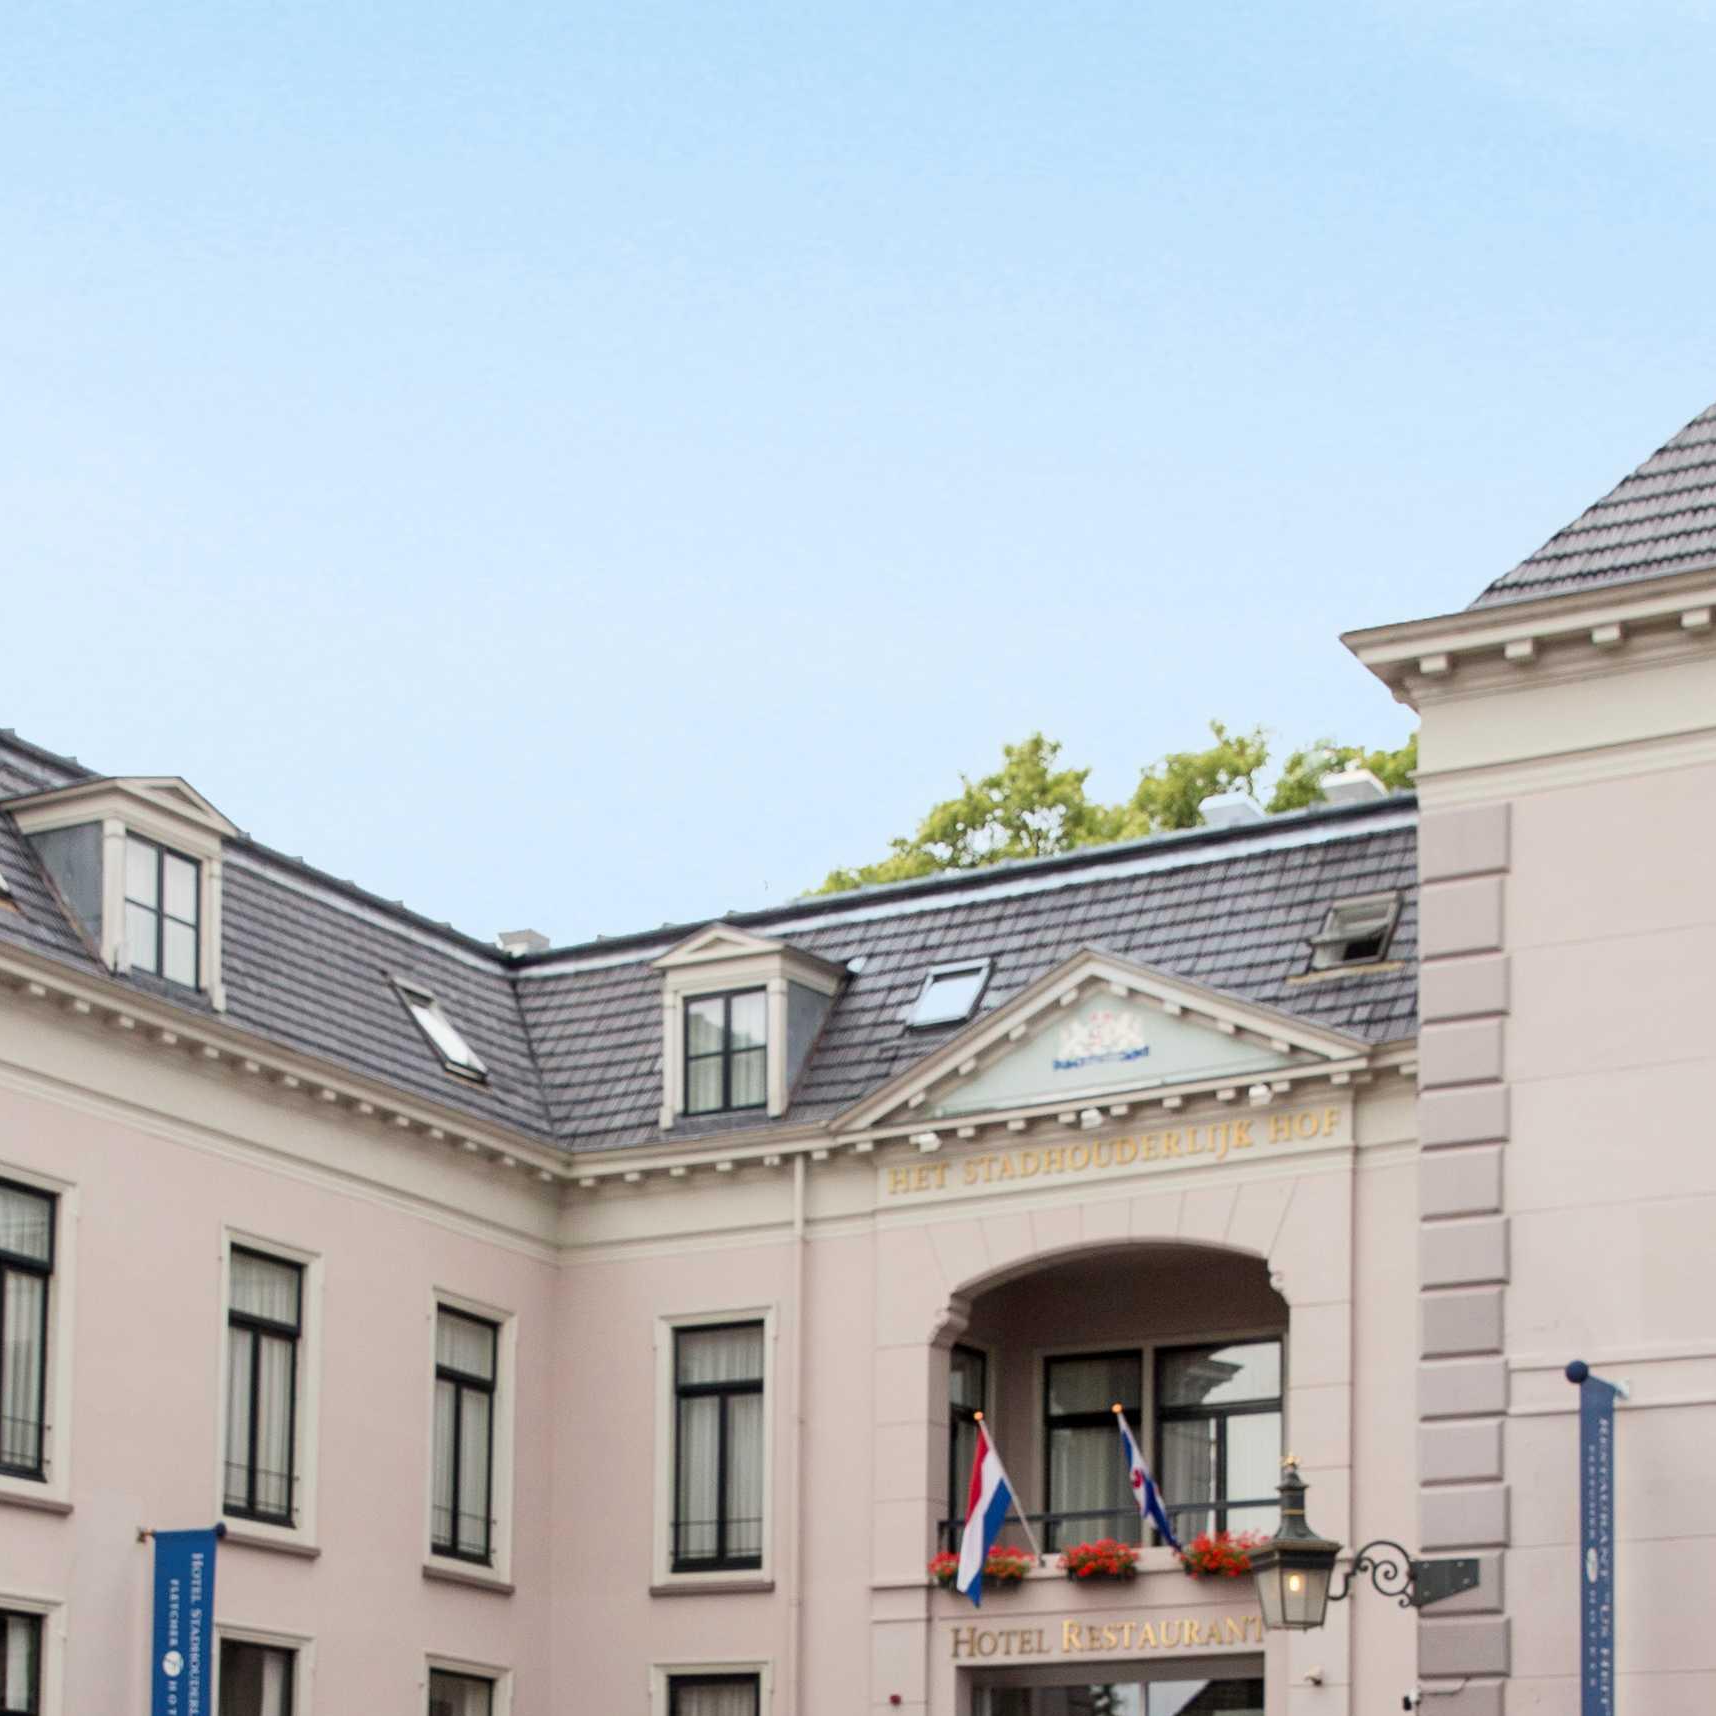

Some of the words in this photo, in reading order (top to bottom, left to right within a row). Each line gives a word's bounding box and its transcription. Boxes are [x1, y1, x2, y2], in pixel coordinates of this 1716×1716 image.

[888, 1160, 951, 1194] HET
[963, 1119, 1254, 1185] STADHOUDERLIJK
[1268, 1106, 1341, 1144] HOF
[190, 1552, 204, 1604] HOTEL
[168, 1579, 180, 1647] FLETCHER
[951, 1624, 1051, 1658] HOTEL
[1061, 1615, 1263, 1654] RESTAURANT
